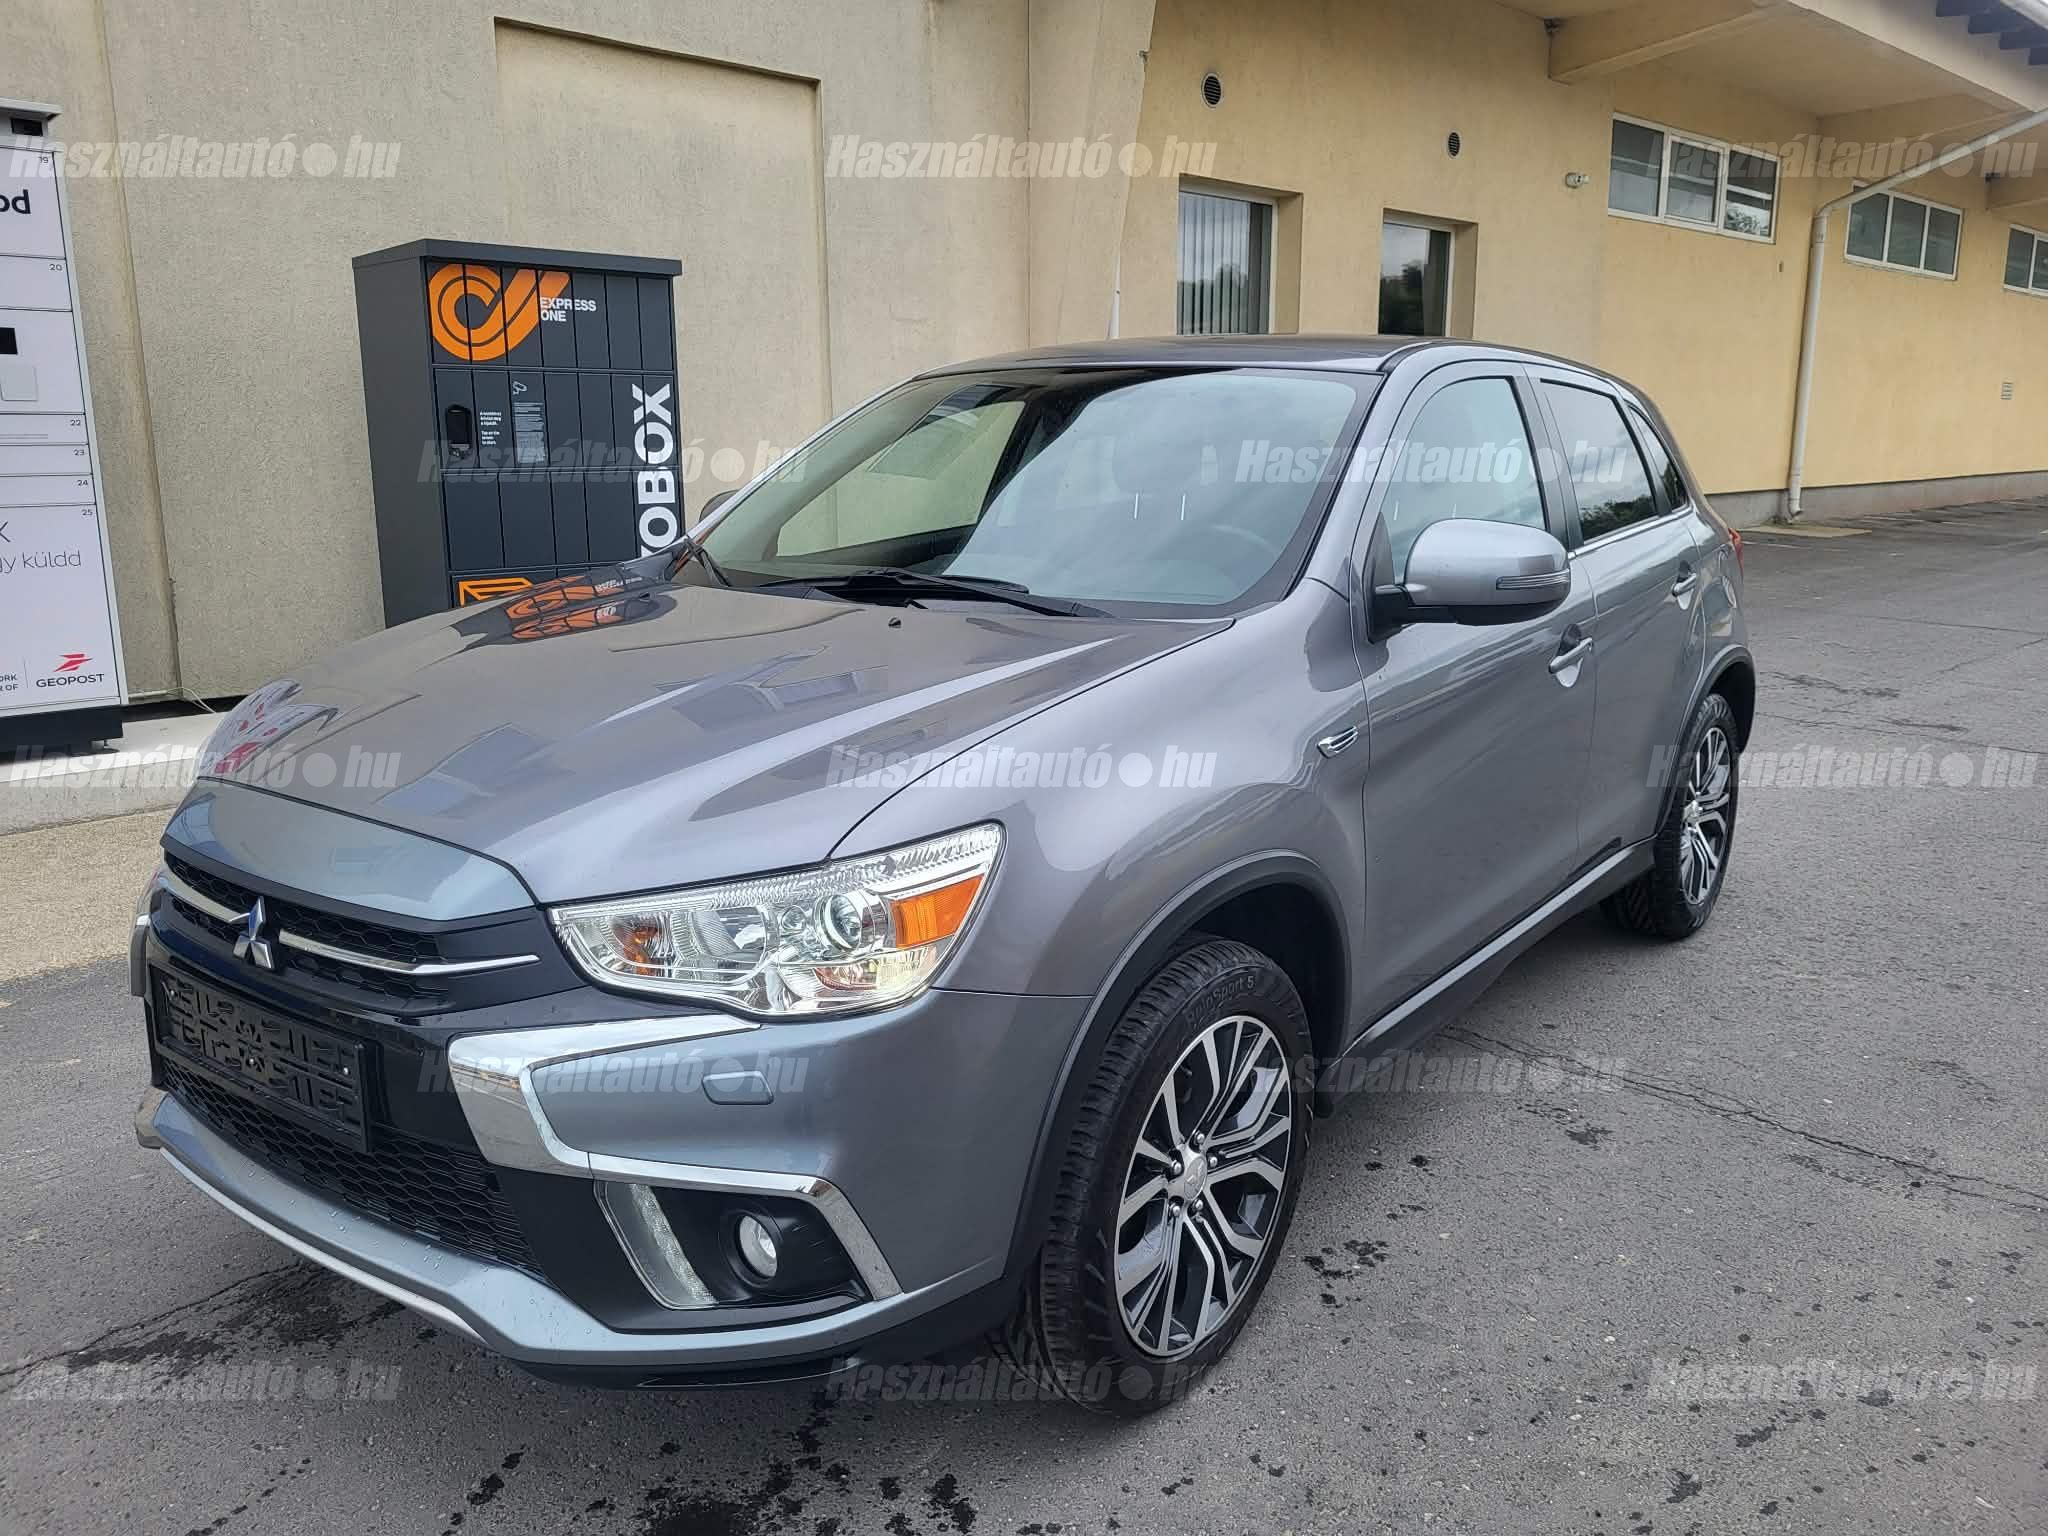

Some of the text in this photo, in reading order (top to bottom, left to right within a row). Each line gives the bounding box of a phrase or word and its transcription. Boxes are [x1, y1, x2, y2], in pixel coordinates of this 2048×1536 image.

[540, 297, 597, 311] EXPRESS
[541, 310, 567, 322] ONE
[77, 479, 89, 487] 24
[22, 549, 81, 569] küldd
[36, 673, 105, 688] GEOPOST
